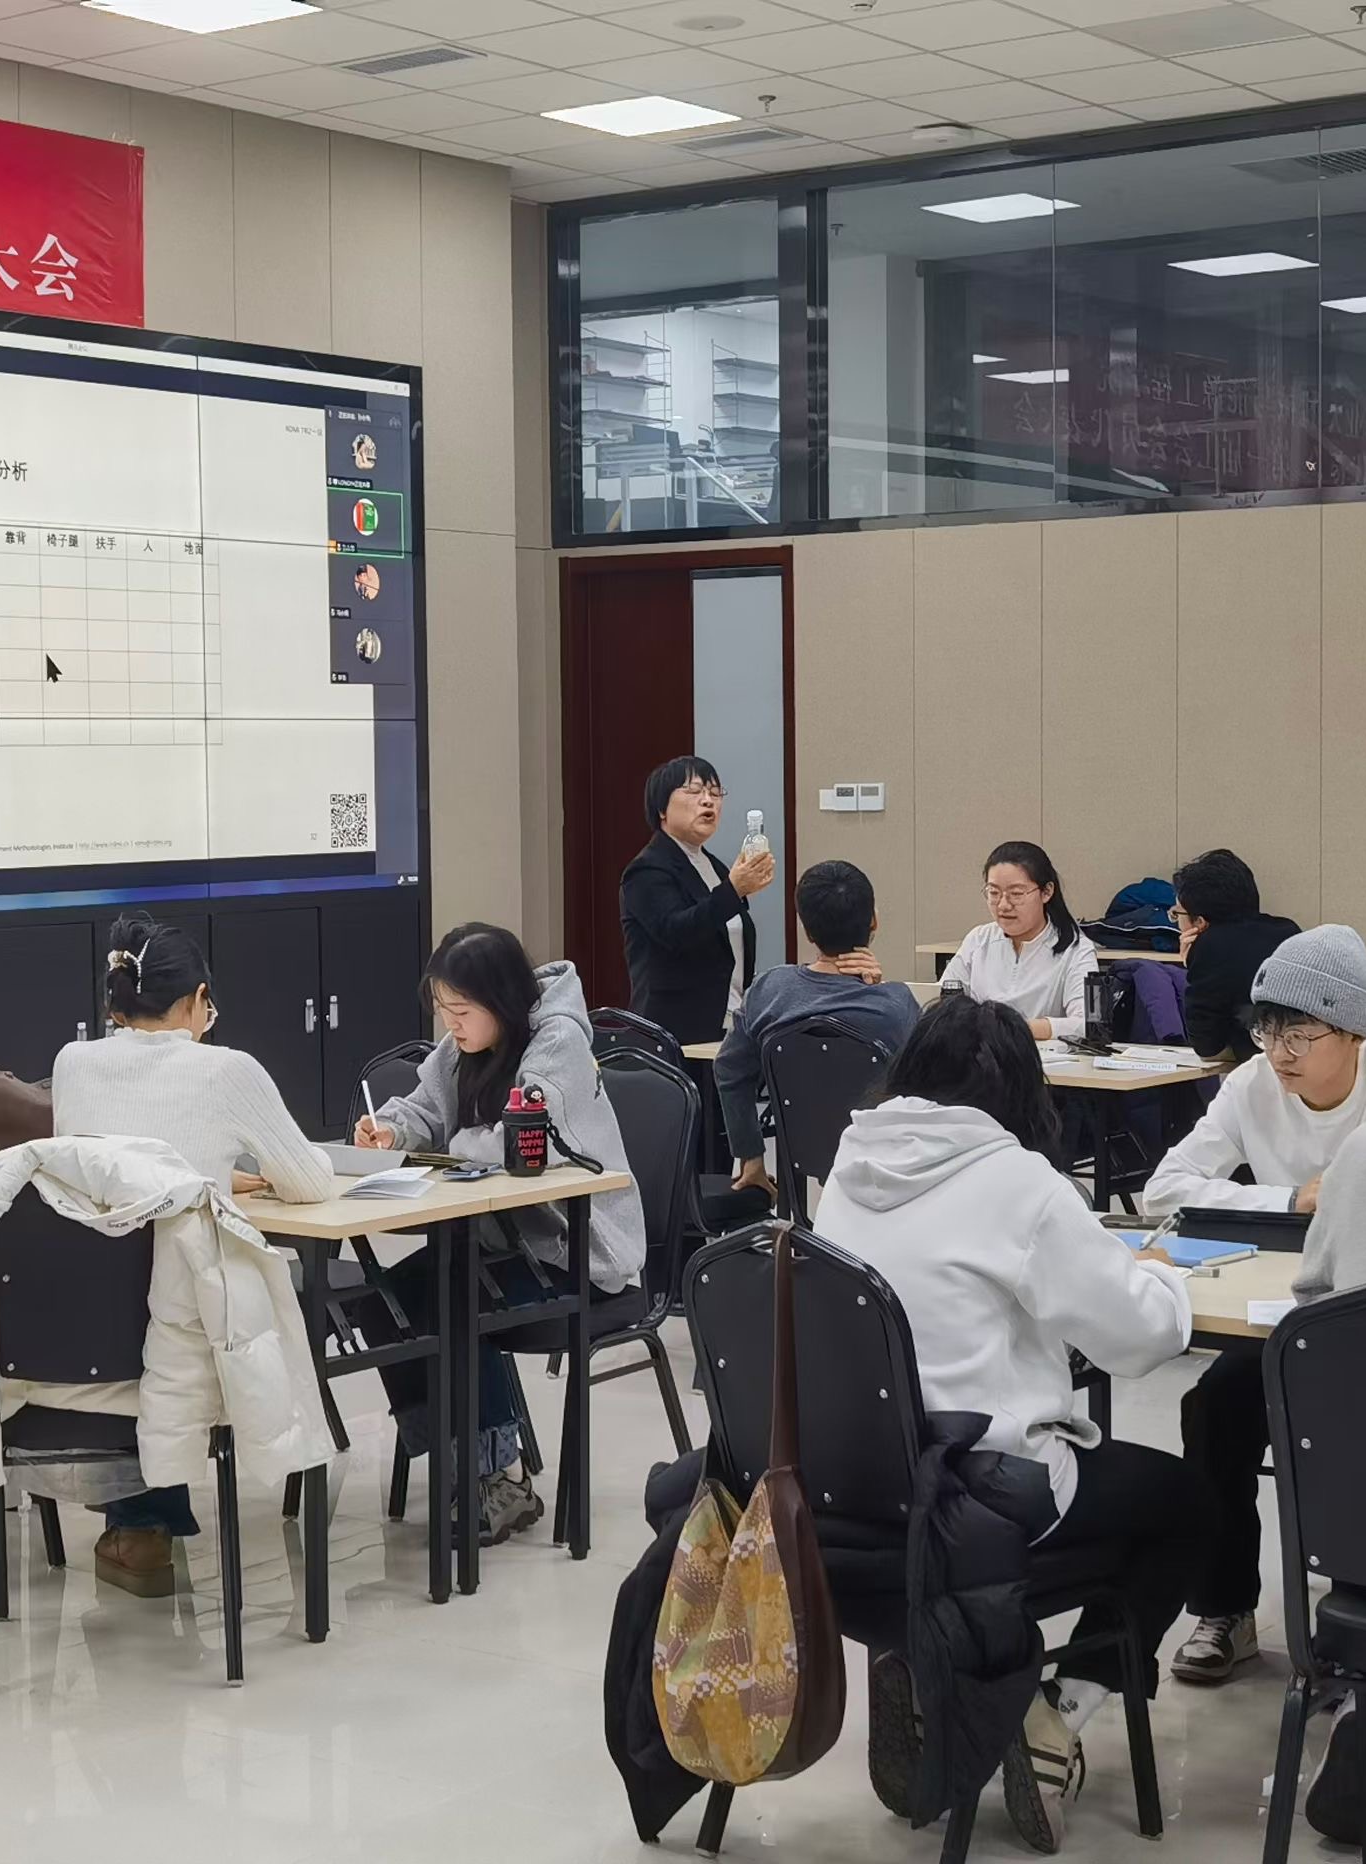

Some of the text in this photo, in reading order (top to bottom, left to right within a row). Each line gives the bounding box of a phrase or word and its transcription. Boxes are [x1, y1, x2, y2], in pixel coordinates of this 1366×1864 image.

[5, 530, 27, 545] 靠背
[46, 532, 79, 549] 椅子腿
[96, 535, 117, 551] 扶手
[142, 538, 154, 553] 人
[184, 540, 204, 556] 地面
